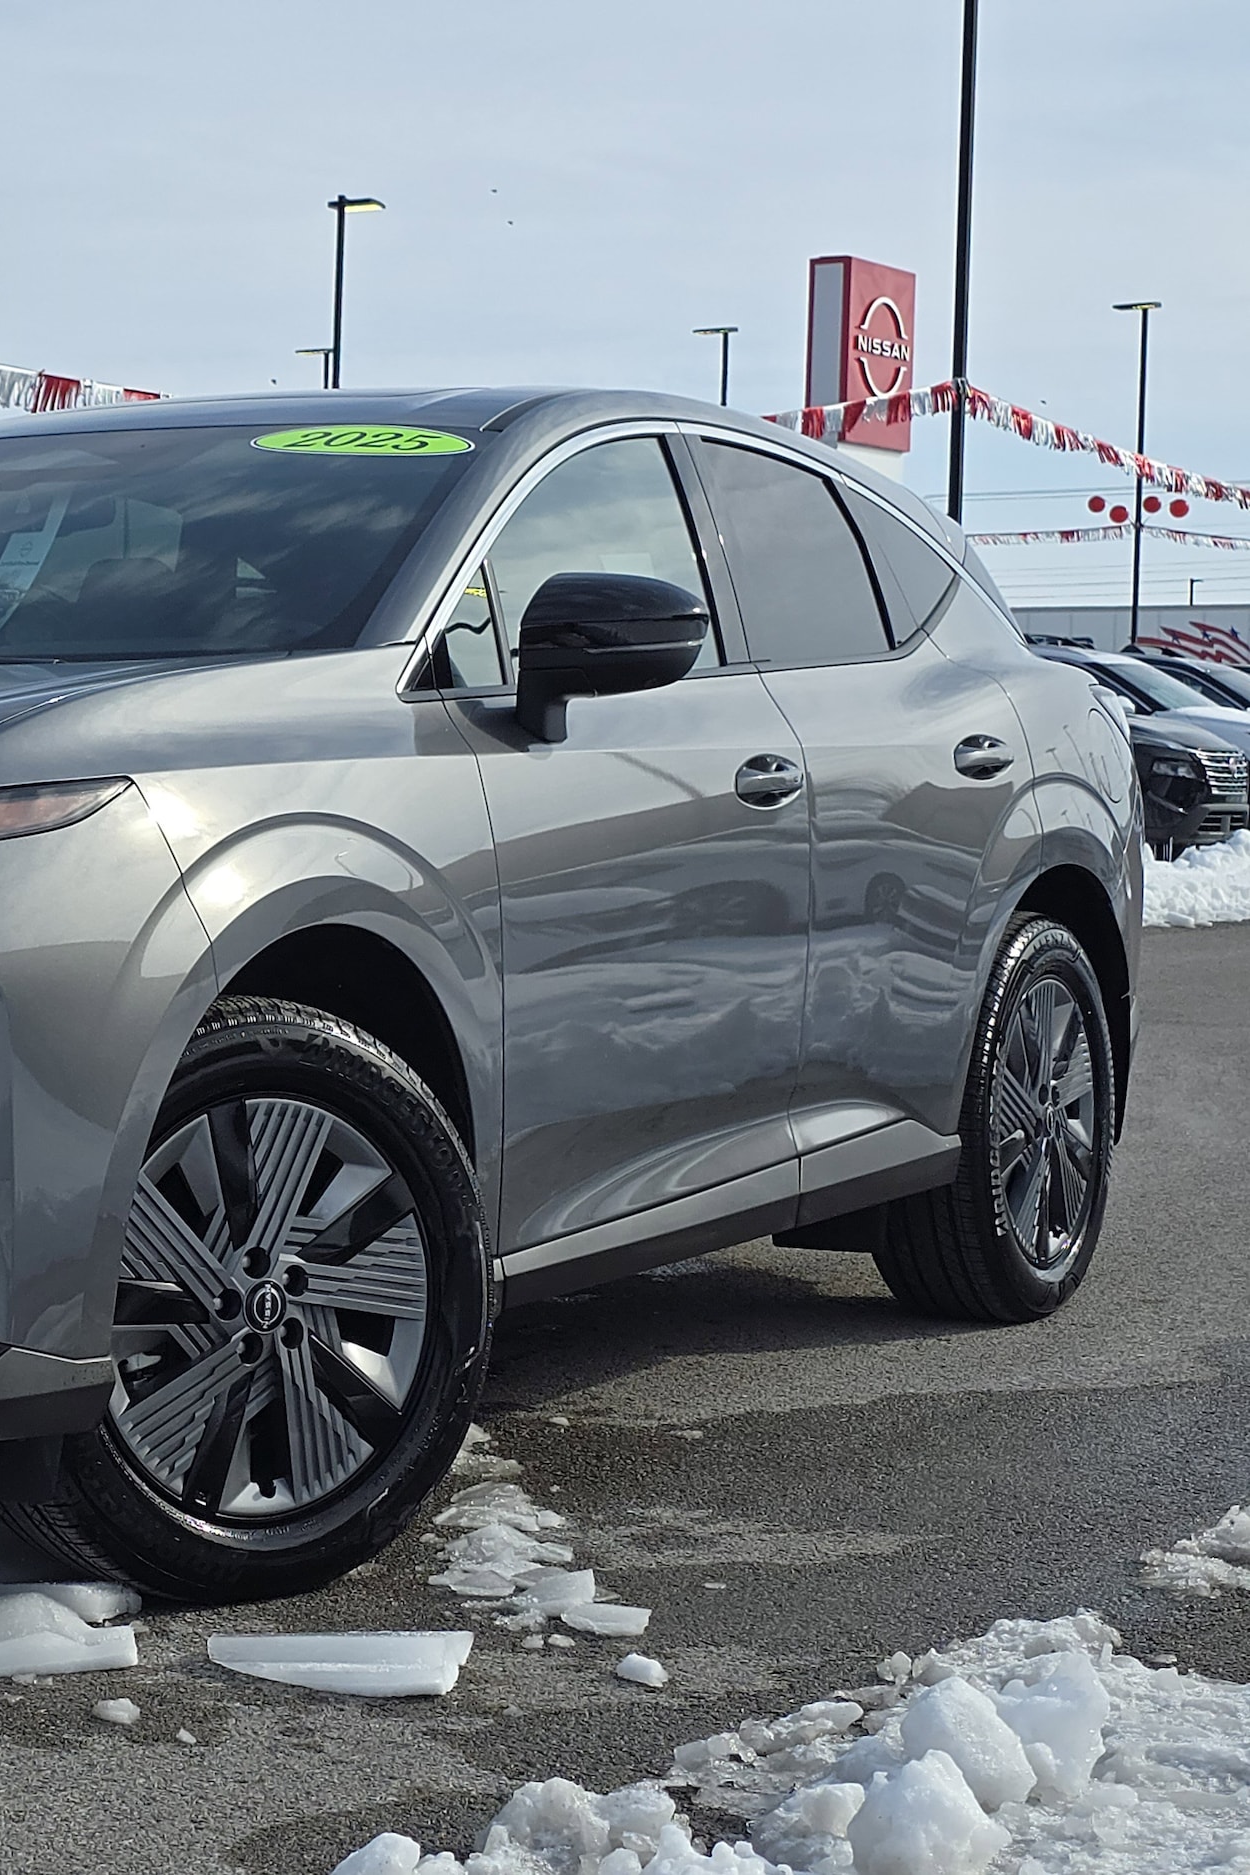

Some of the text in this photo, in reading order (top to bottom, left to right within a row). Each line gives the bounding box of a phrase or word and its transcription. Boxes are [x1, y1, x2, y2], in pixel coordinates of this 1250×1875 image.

[857, 334, 909, 361] NISSAN
[283, 431, 442, 451] 2025
[261, 1284, 271, 1329] NISSAN
